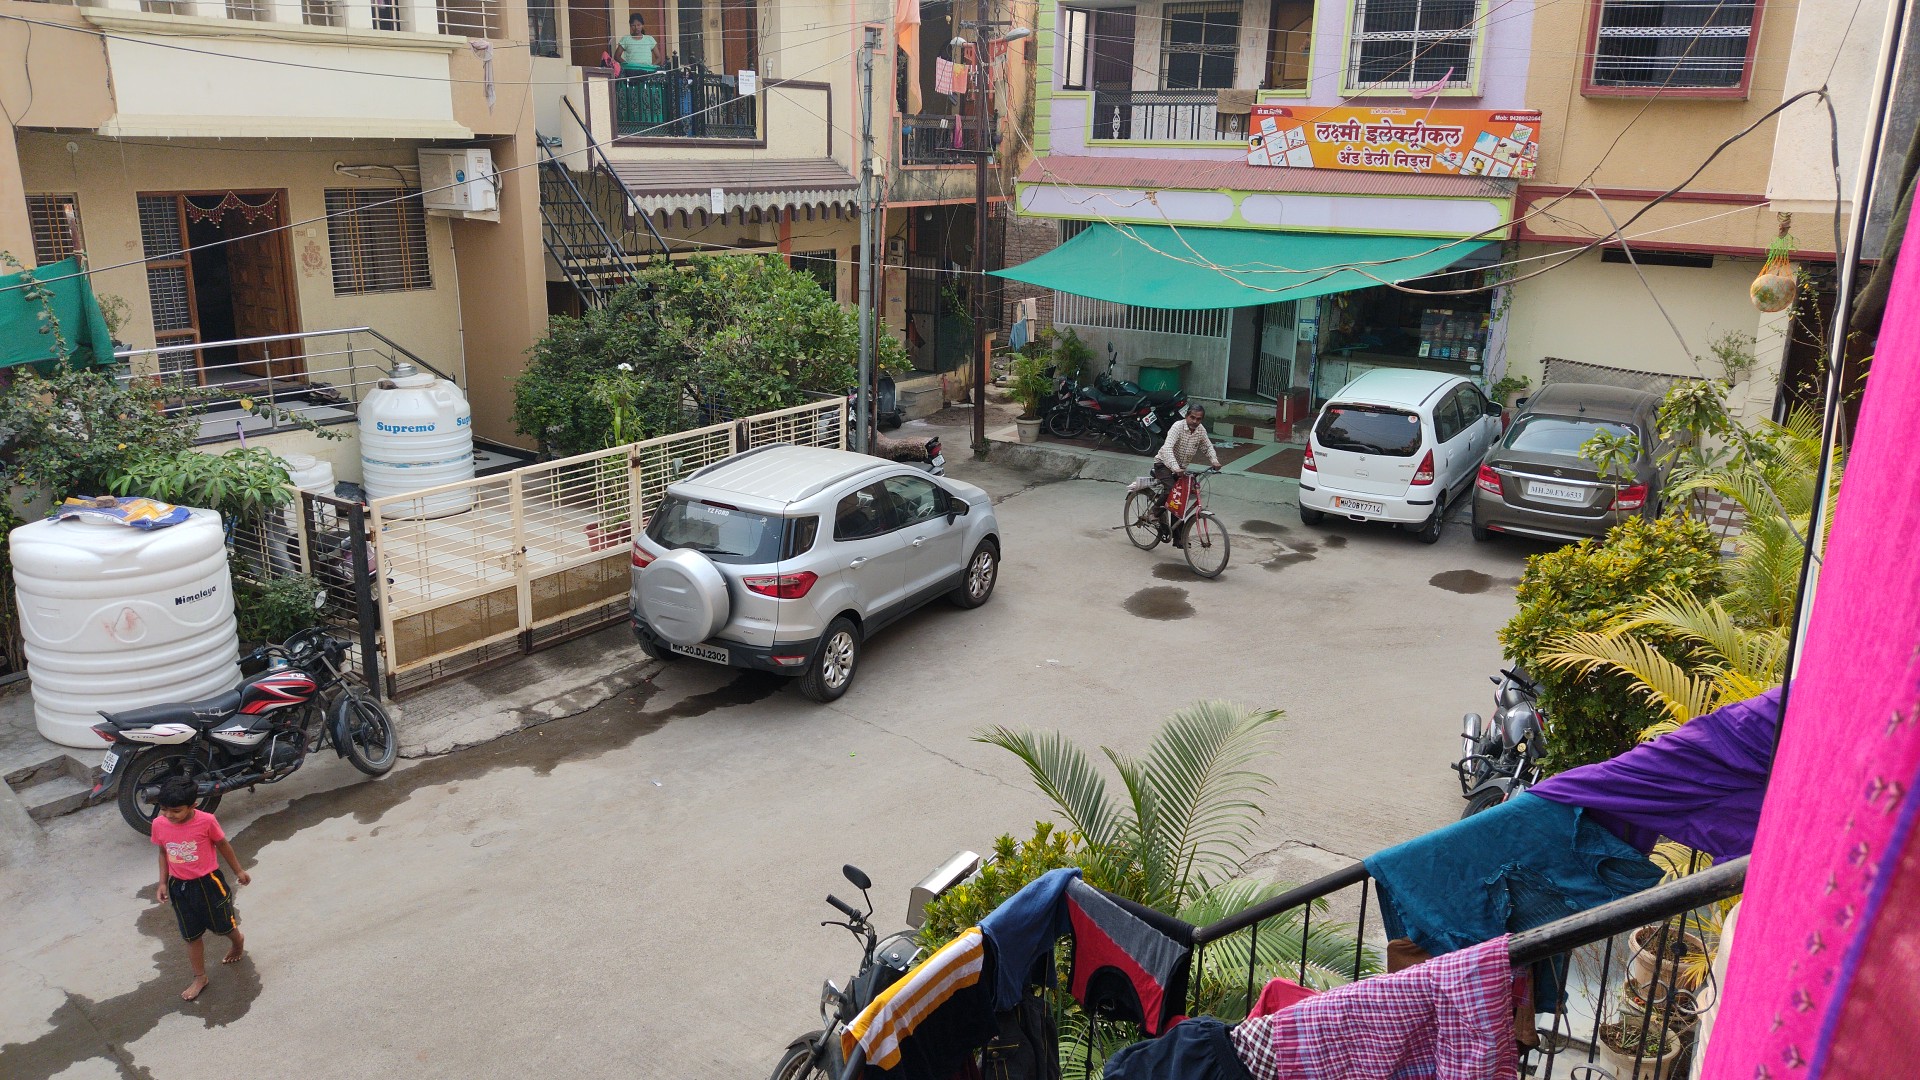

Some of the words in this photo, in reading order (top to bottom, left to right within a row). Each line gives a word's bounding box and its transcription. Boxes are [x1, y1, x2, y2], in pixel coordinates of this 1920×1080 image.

[1316, 119, 1361, 142] लक्ष्मी
[1366, 119, 1462, 149] इलेक्ट्रीकल
[1339, 146, 1361, 164] अँड
[1365, 148, 1390, 166] डेली
[1393, 150, 1432, 173] निड्स
[376, 421, 436, 434] Supremo
[1340, 500, 1380, 513] MH20BY7714
